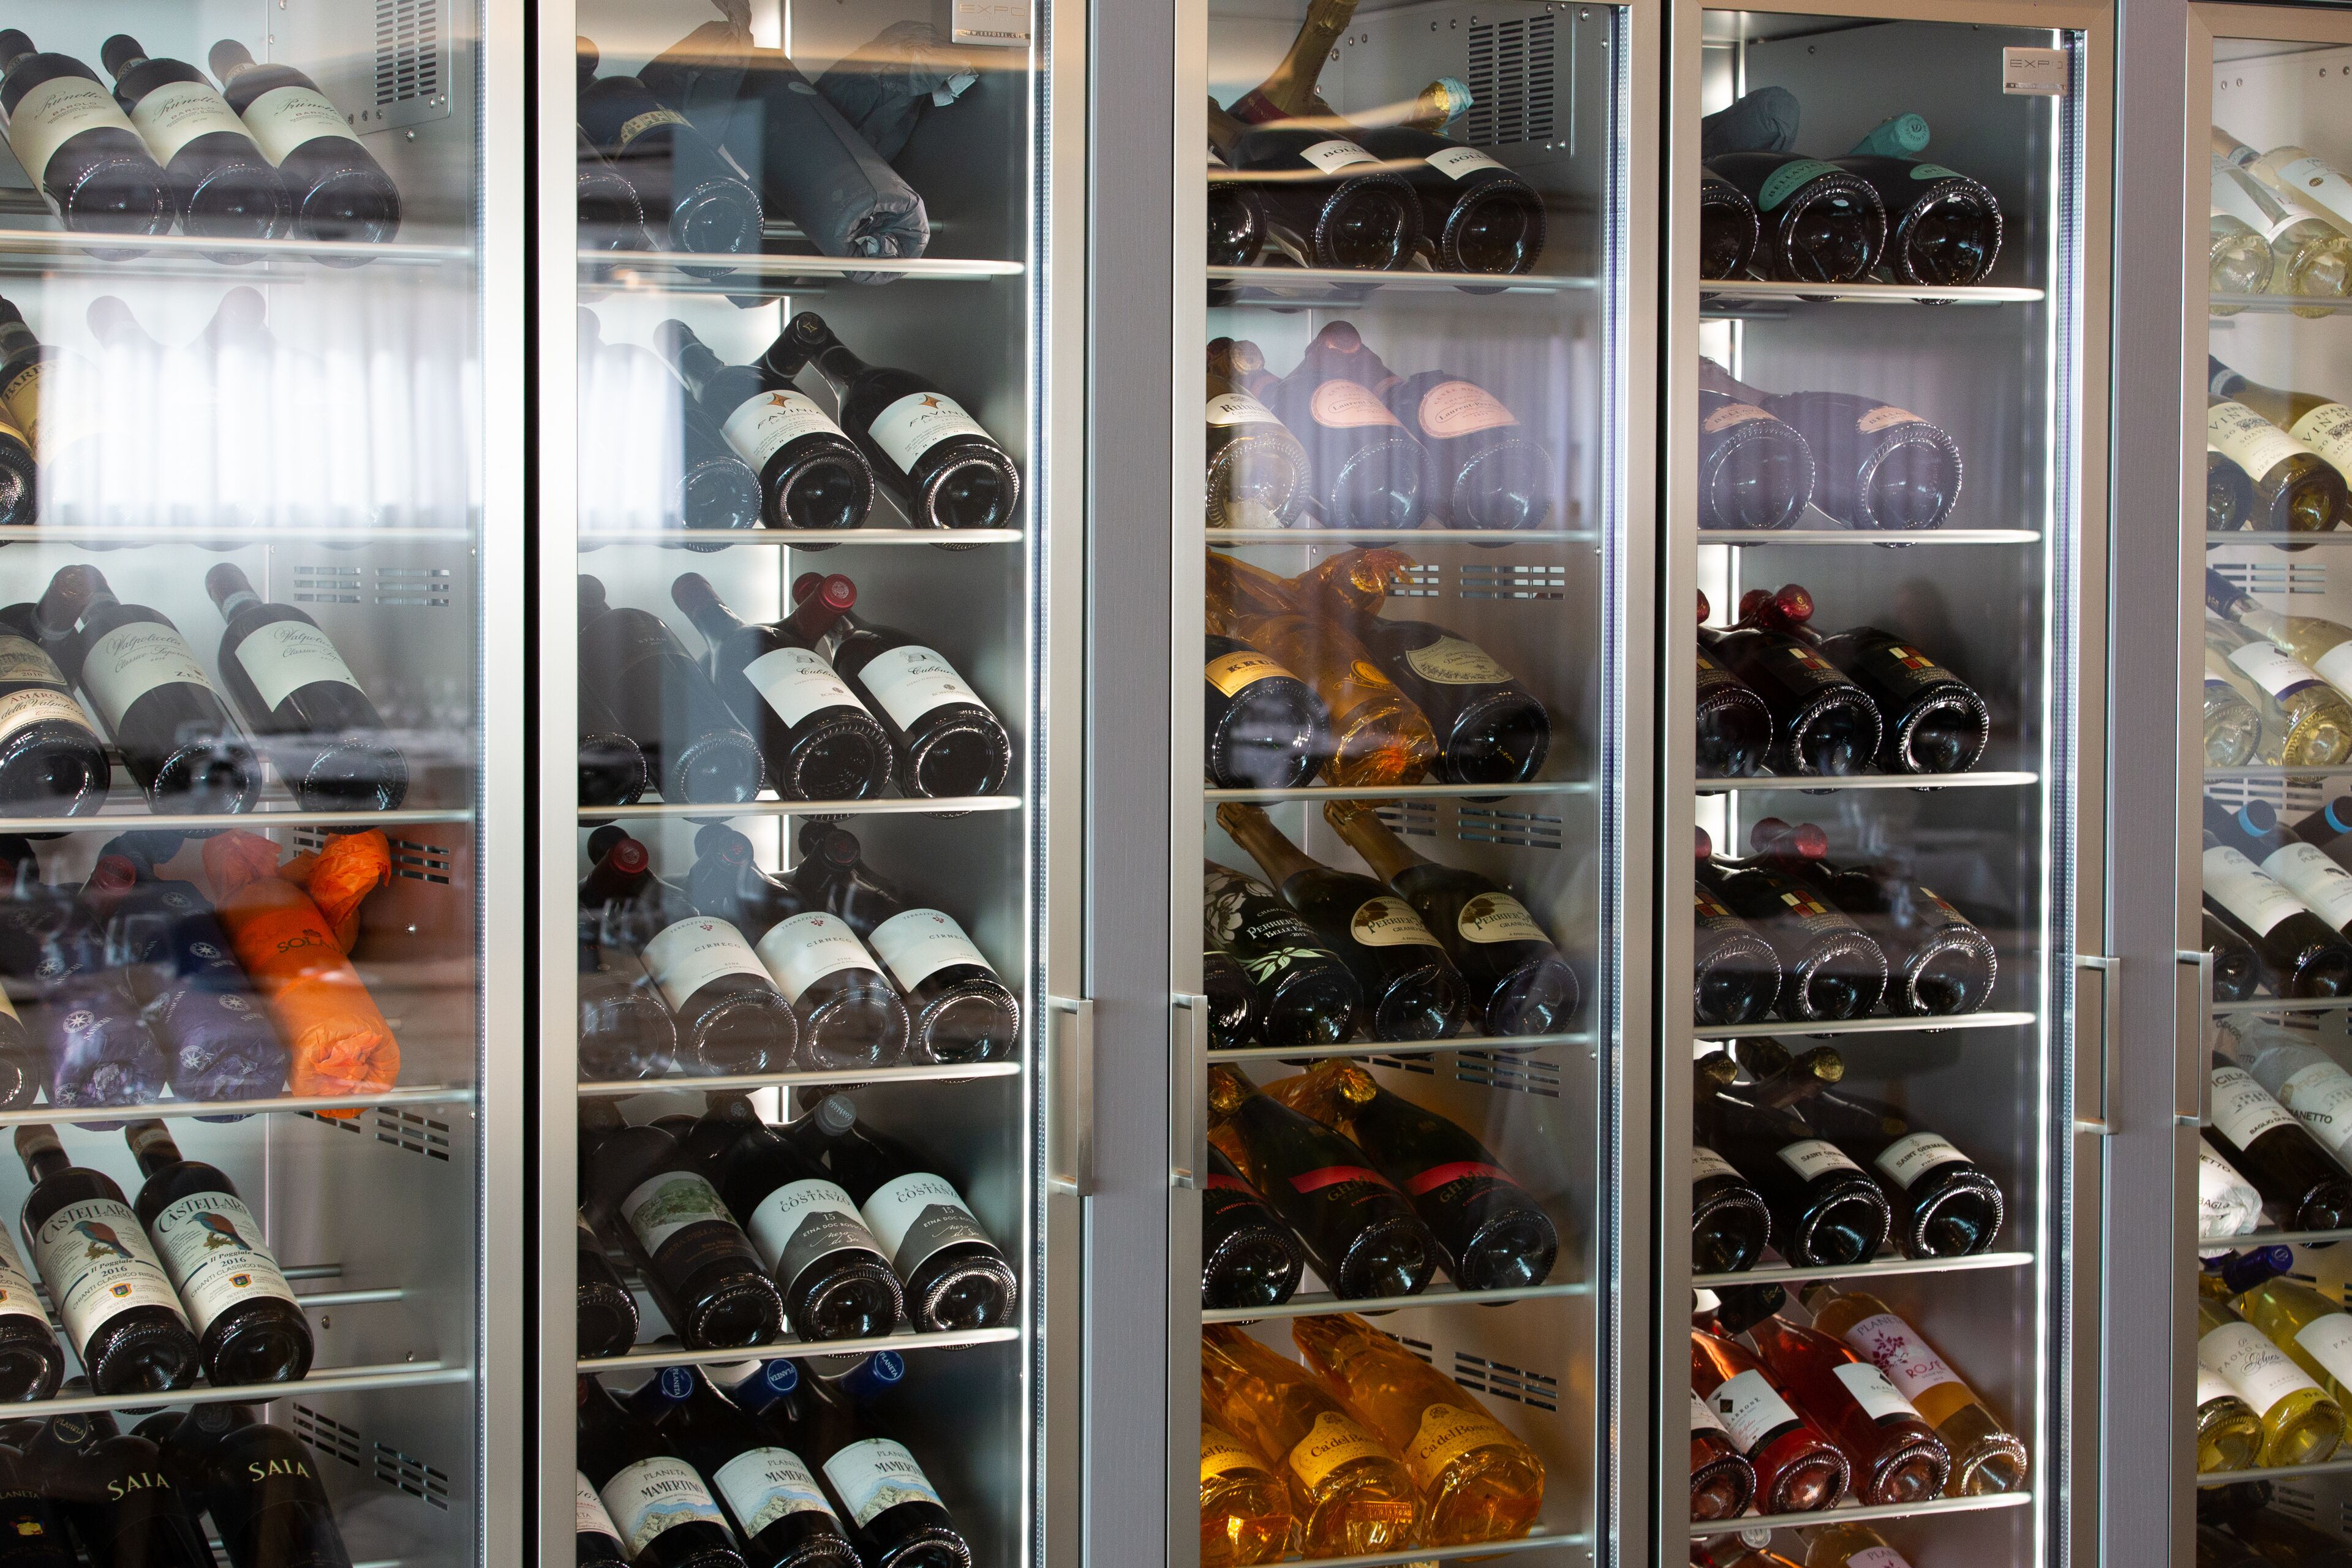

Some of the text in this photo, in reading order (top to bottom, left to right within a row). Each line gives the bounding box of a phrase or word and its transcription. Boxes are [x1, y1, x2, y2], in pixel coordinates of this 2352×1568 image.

[959, 4, 1025, 17] EXPO
[53, 102, 97, 116] BAROLO
[171, 107, 215, 120] BAROLO
[2302, 420, 2332, 443] VIN
[1246, 919, 1295, 940] PERRIER
[1263, 927, 1292, 938] BELLE
[694, 942, 741, 952] CIRNECO
[806, 937, 853, 948] CIRNECO
[1896, 1150, 1917, 1168] SAINT
[781, 1193, 851, 1213] COSTANZO
[823, 1213, 836, 1221] 15
[923, 1218, 942, 1228] ETNA
[803, 1226, 821, 1238] ETNA
[218, 1249, 252, 1259] Poggiale
[99, 1258, 134, 1270] Poggiale
[221, 1256, 247, 1268] 2016
[101, 1265, 128, 1278] 2016
[190, 1275, 216, 1298] CHIANTI
[216, 1262, 257, 1276] CLASSICO
[73, 1284, 97, 1310] CHIANTI
[97, 1271, 138, 1286] CLASSICO
[880, 1354, 899, 1378] PLANETA
[769, 1366, 796, 1382] PLANETA
[672, 1367, 681, 1397] PLANETA
[55, 1416, 85, 1436] PLANETA
[248, 1459, 311, 1482] SAIA
[644, 1469, 687, 1481] PLANETA
[107, 1472, 171, 1501] SAIA
[640, 1480, 703, 1501] MAMERTINO
[0, 1490, 40, 1500] LANETA
